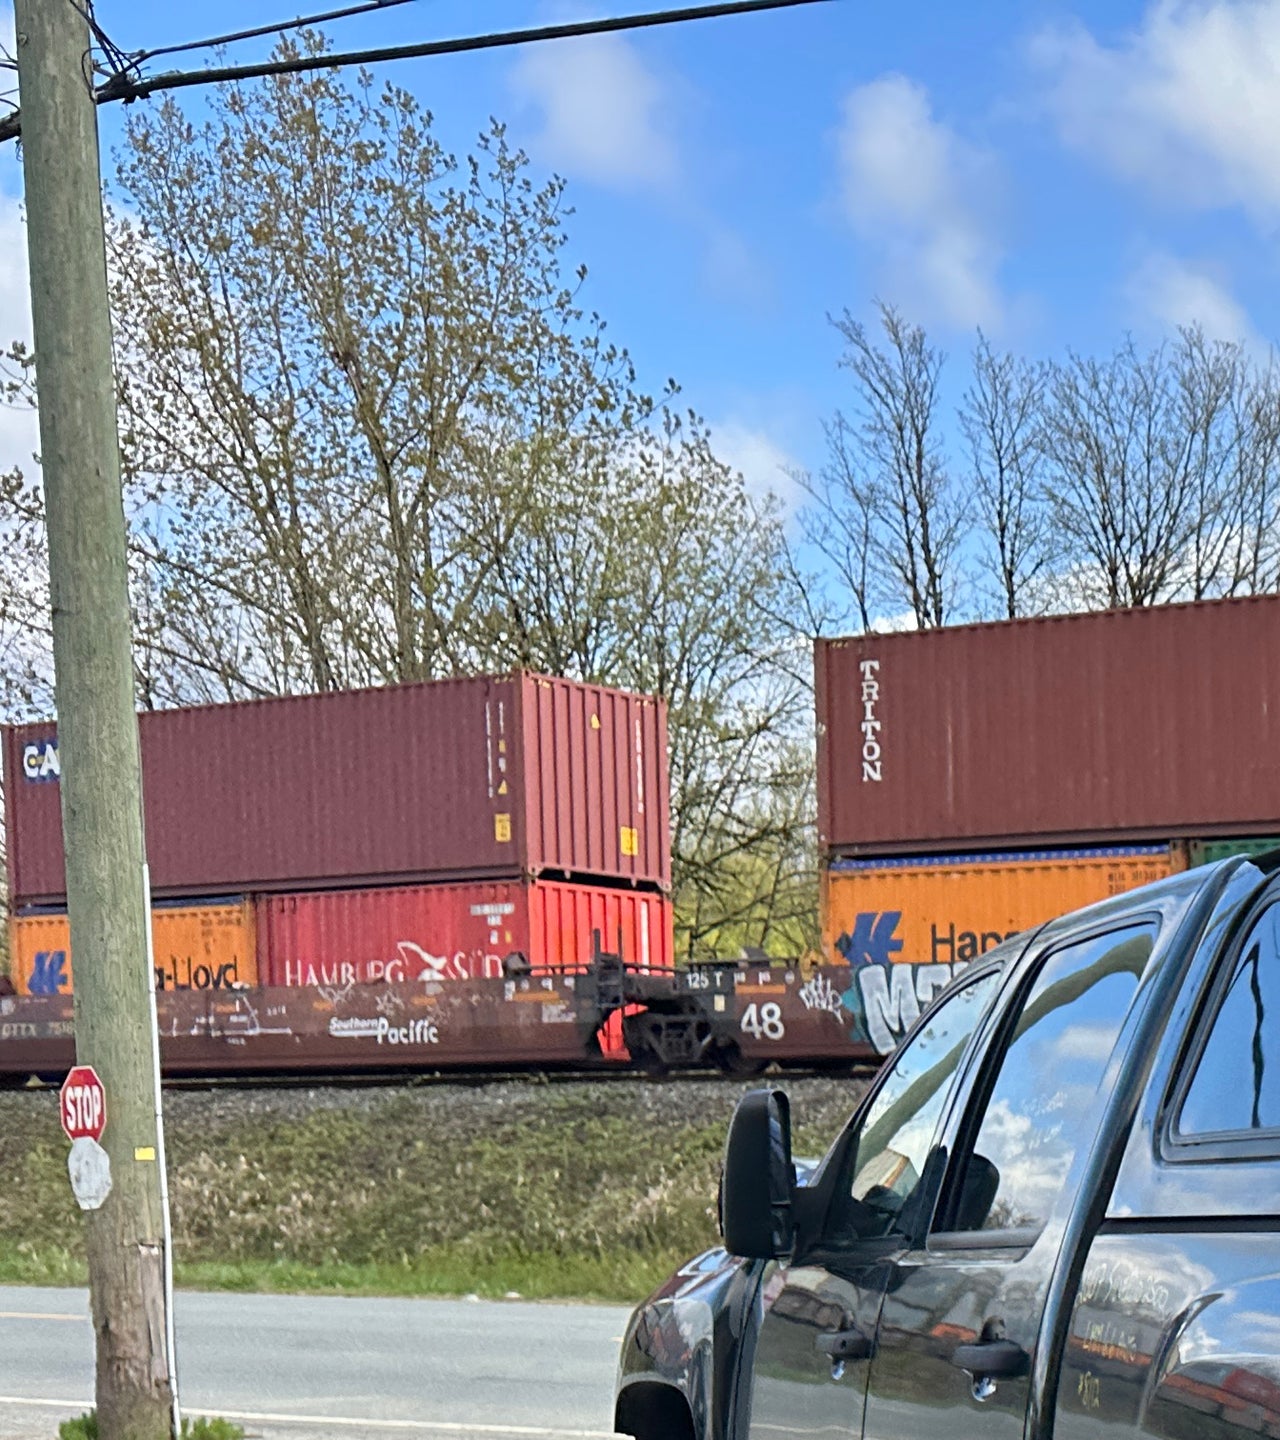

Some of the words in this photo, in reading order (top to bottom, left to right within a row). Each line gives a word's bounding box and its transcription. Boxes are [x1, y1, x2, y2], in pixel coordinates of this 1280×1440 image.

[860, 660, 882, 782] TRITON
[23, 743, 60, 778] CA
[931, 922, 1020, 963] Hap
[285, 958, 404, 986] HAMBURG
[377, 1017, 439, 1044] Pacific
[741, 1002, 784, 1040] 48
[65, 1085, 100, 1131] STOP
